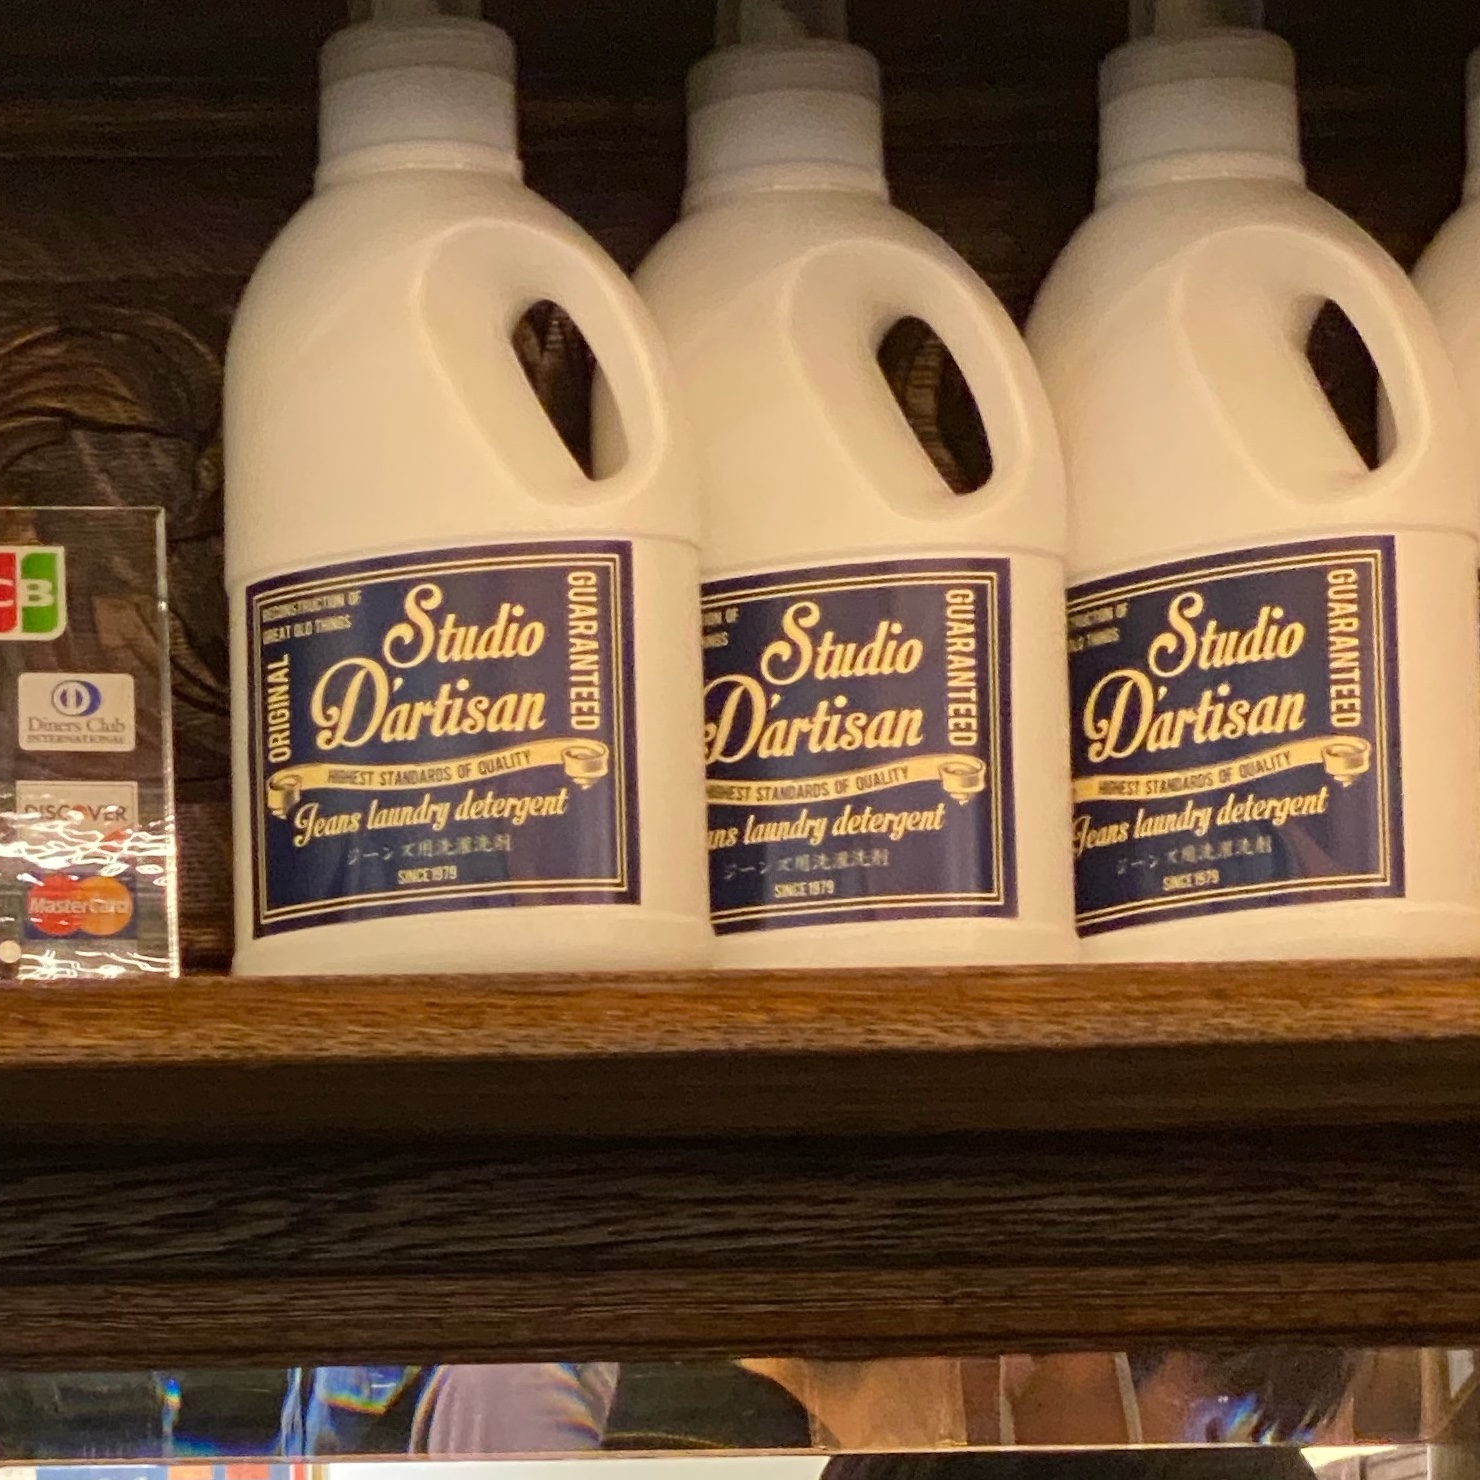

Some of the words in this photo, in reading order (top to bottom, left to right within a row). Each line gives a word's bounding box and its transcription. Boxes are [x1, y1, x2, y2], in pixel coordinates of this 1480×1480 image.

[383, 583, 545, 668] Studio
[567, 571, 601, 731] GUARANTEED
[760, 601, 924, 686] Studio
[1148, 592, 1306, 678] Studio
[1327, 568, 1362, 728] GUARANTEED
[945, 588, 978, 747] GUARANTEED
[26, 734, 125, 745] INTERNATIONAL
[28, 716, 81, 733] Diners
[85, 716, 126, 733] Club
[268, 653, 291, 764] ORIGINAL
[311, 657, 545, 751] D'artisan
[702, 674, 924, 764] D'artisan
[1084, 668, 1307, 763] D'artisan
[328, 769, 375, 786] HIGHEST
[379, 766, 452, 786] STANDARDS
[457, 762, 472, 779] OF
[477, 750, 531, 776] QUALITY
[757, 782, 829, 802] STANDARDS
[834, 778, 849, 795] OF
[856, 765, 909, 791] QUALITY
[1145, 772, 1214, 795] STANDARDS
[1218, 768, 1234, 784] OF
[1239, 750, 1292, 779] QUALITY
[23, 803, 128, 823] DISCOVER
[294, 803, 362, 847] Jeans
[367, 793, 451, 831] laundry
[455, 787, 569, 825] detergent
[708, 826, 740, 850] ans
[743, 808, 828, 846] laundry
[831, 802, 946, 841] detergent
[1072, 815, 1131, 858] Jeans
[1133, 799, 1213, 836] laundry
[1216, 786, 1330, 827] detergent
[27, 896, 133, 915] MasterCard
[431, 865, 458, 882] 1979
